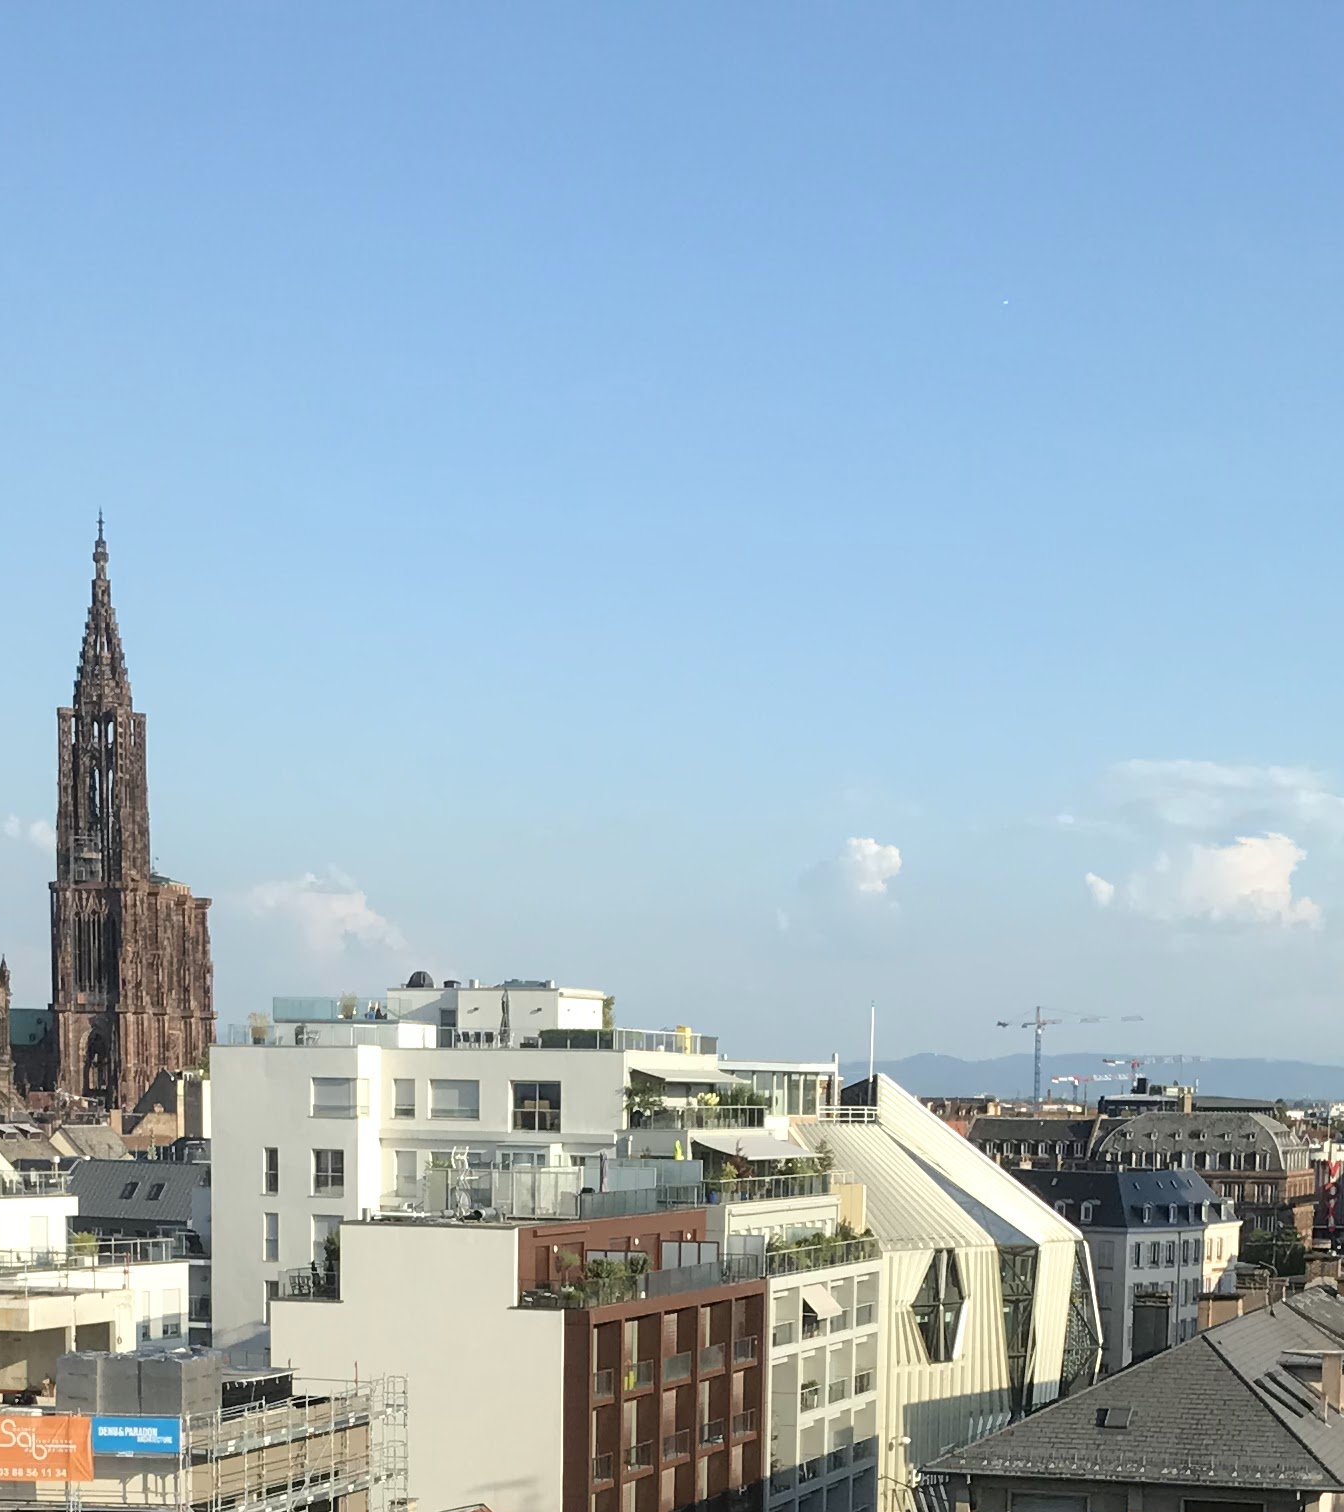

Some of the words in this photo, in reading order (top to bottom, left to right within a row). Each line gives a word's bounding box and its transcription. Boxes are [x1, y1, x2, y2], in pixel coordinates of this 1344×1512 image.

[12, 1468, 23, 1478] 88
[26, 1468, 39, 1478] 56
[41, 1468, 52, 1478] 11
[55, 1468, 67, 1478] 34
